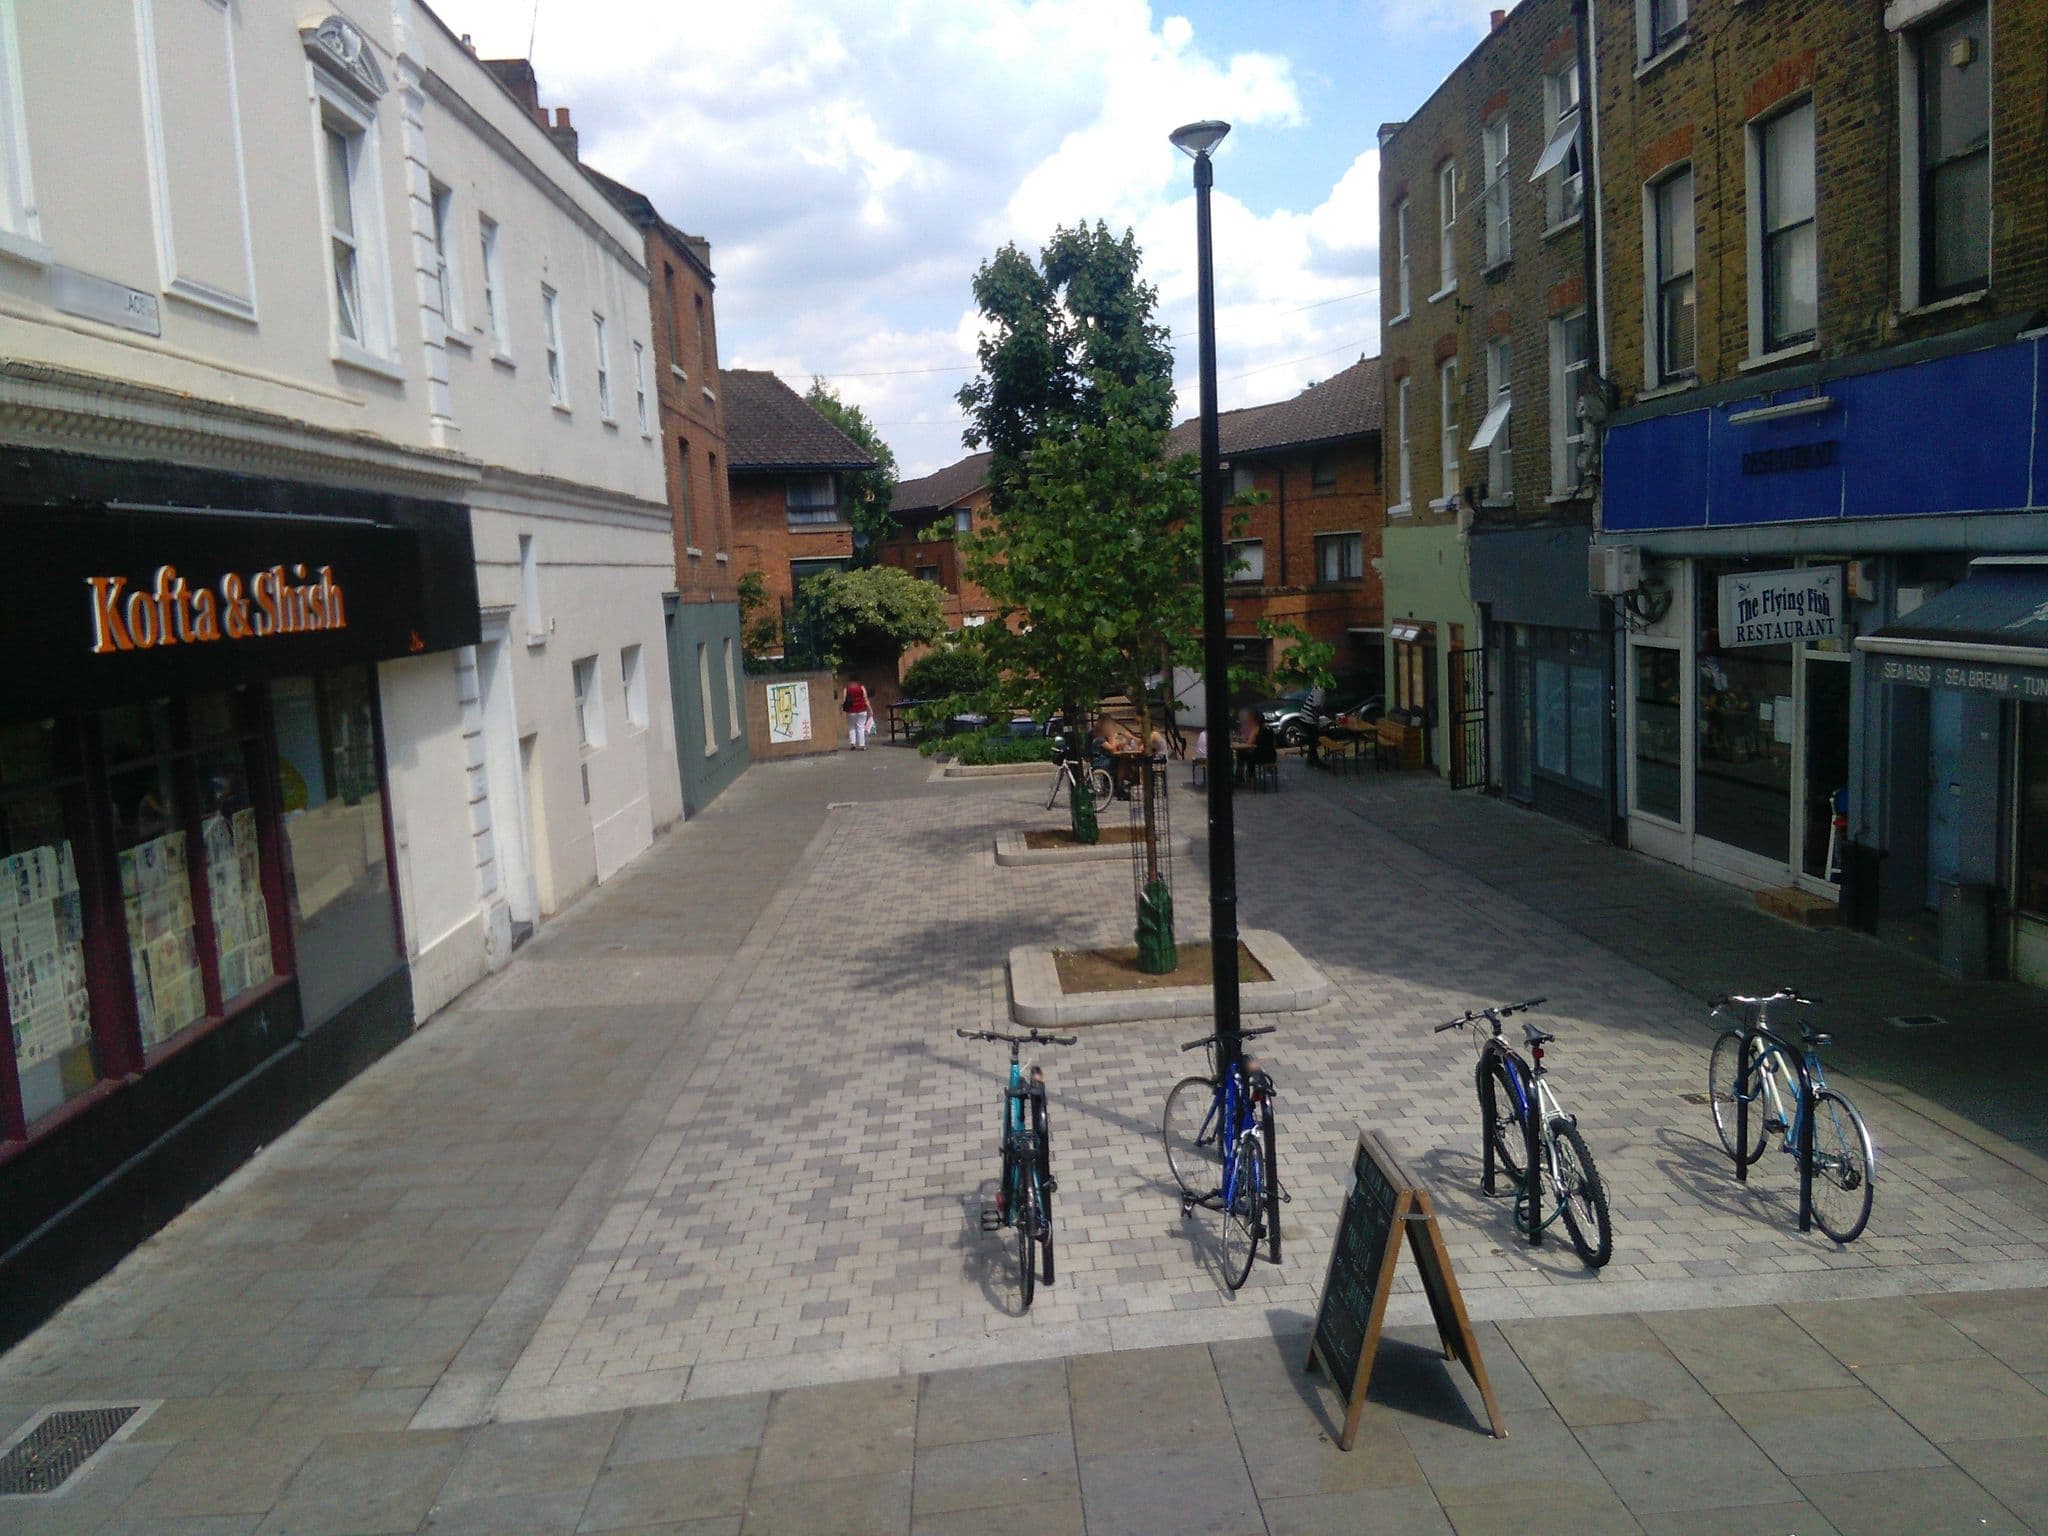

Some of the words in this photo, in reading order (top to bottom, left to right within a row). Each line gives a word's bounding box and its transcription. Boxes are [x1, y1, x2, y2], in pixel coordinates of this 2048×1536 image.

[86, 564, 220, 654] Kofta
[251, 562, 347, 636] Shish
[1737, 597, 1759, 624] The
[1762, 587, 1804, 616] Flying
[1807, 588, 1830, 618] Fish
[1737, 618, 1834, 642] RESTAURANT
[1883, 661, 1904, 679] SEA
[1905, 663, 1932, 683] BASS
[1945, 667, 1967, 687] SEA
[1968, 669, 2009, 691] BREAM
